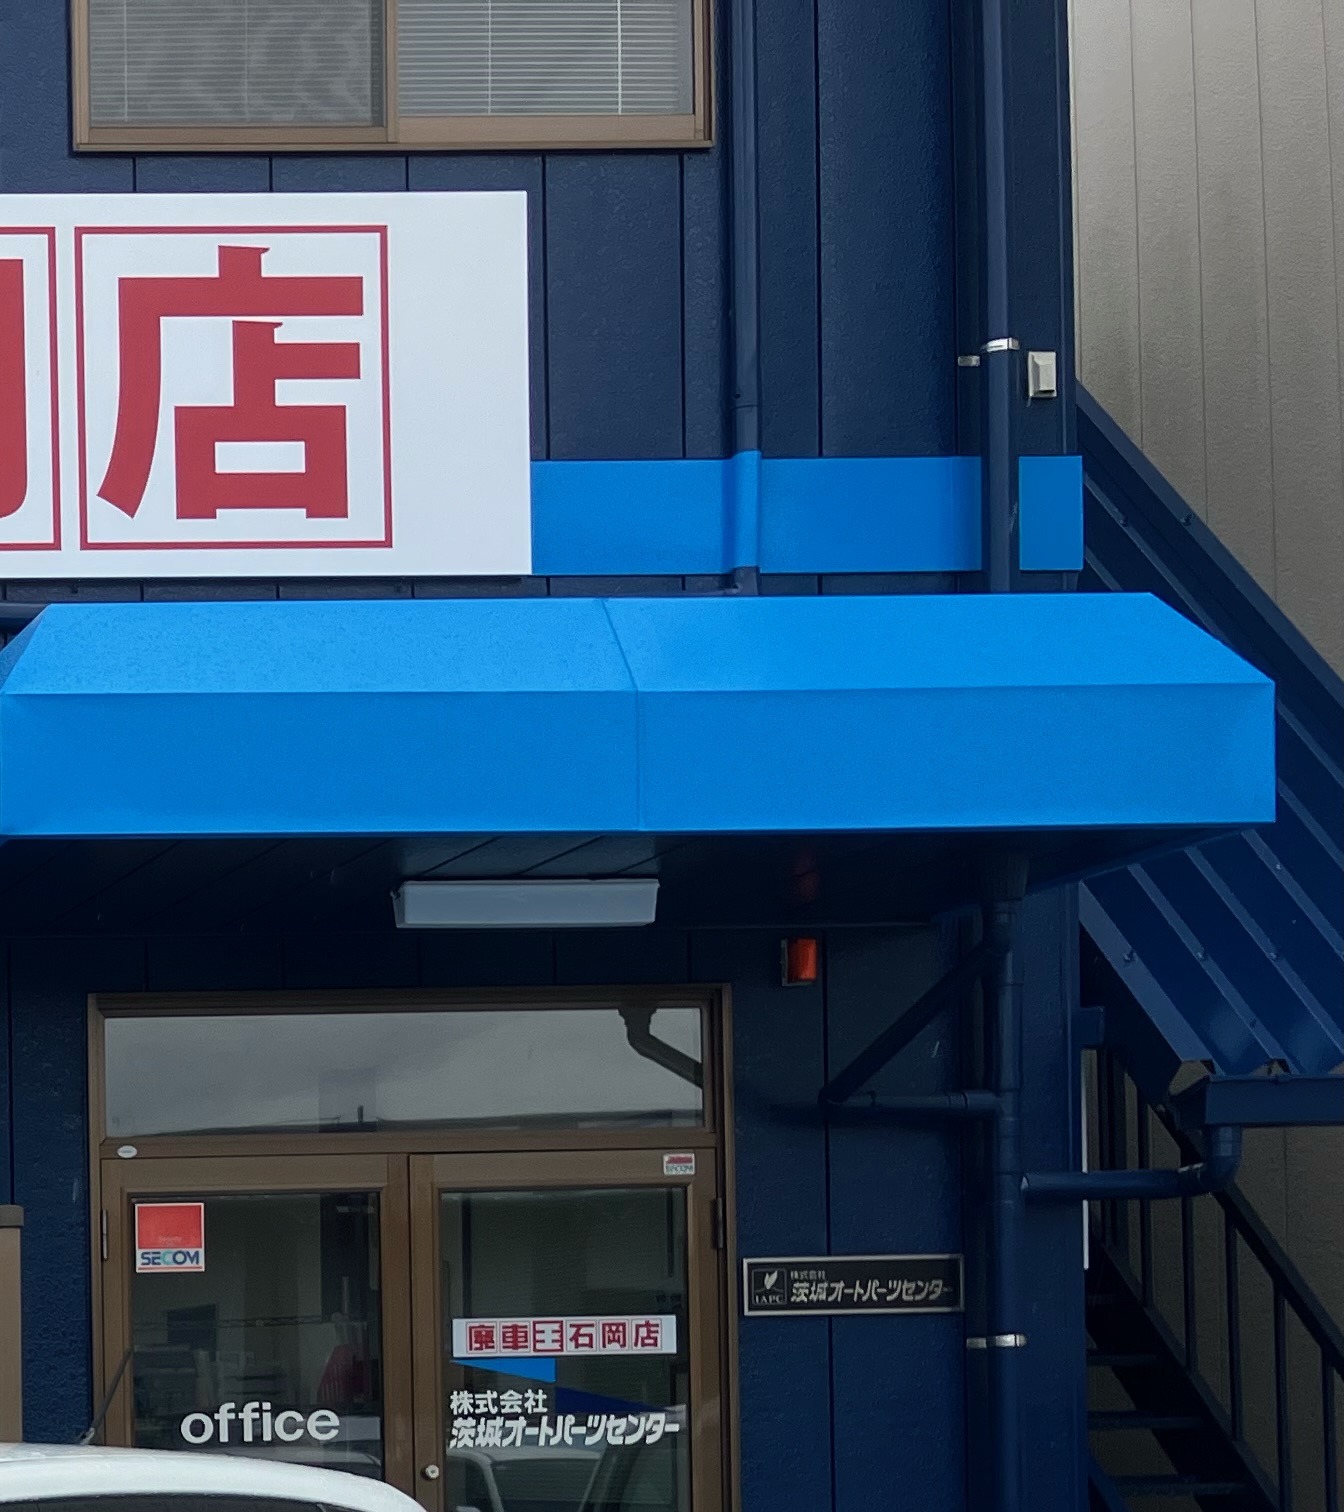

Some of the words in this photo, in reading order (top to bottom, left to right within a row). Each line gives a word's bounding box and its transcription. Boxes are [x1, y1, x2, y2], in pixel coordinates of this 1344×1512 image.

[140, 1250, 200, 1266] SECOM
[790, 1270, 826, 1280] 株式会社
[790, 1279, 953, 1303] 茨城オートパーツセンター
[467, 1320, 660, 1353] 廃車王石岡店
[450, 1389, 548, 1415] 株式会社
[180, 1401, 340, 1444] office
[450, 1412, 679, 1449] 茨城オートパーツセンター
